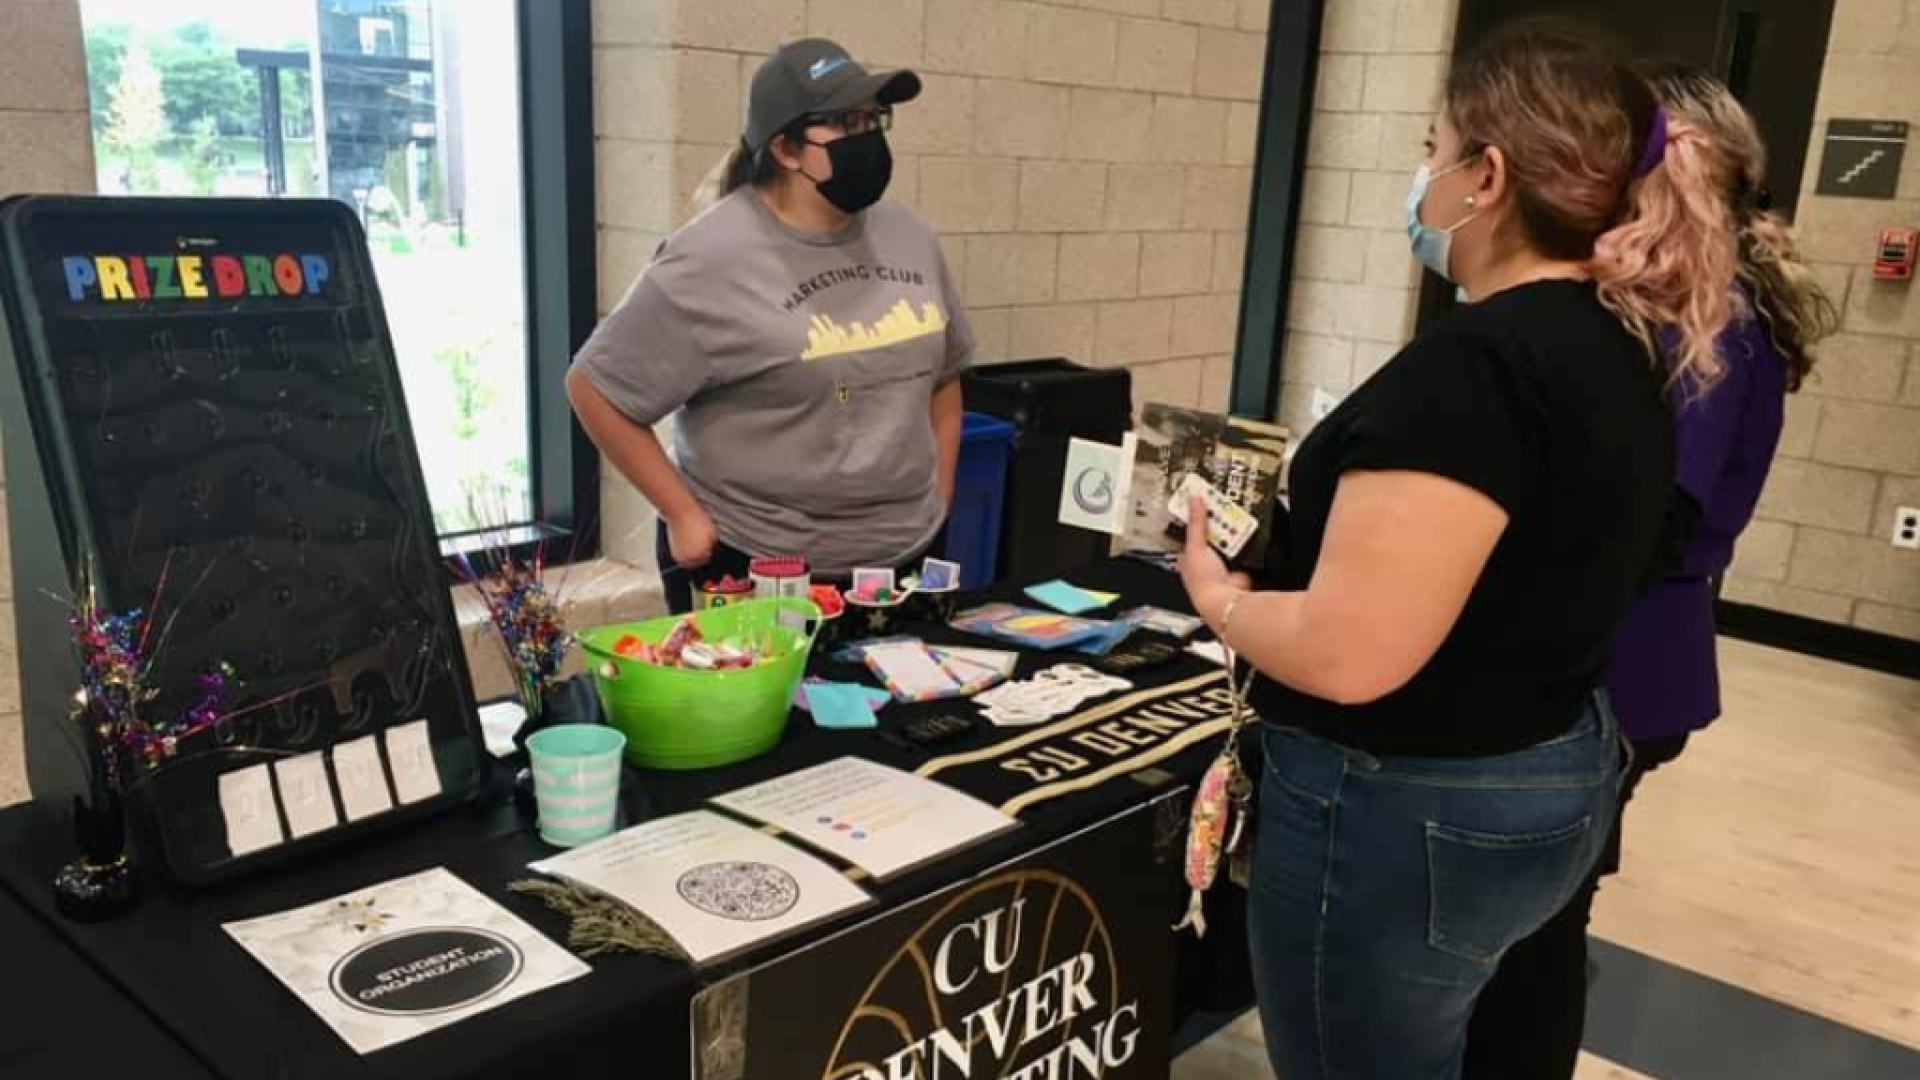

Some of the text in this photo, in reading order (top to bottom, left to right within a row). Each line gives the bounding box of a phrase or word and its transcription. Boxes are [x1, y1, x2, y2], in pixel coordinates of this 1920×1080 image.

[63, 253, 329, 301] PRIZE DROP
[784, 265, 924, 310] MARKETING CLUB
[1001, 688, 1233, 782] CU DENVER
[359, 946, 504, 1001] ORGANIZATION
[376, 947, 465, 982] STUDENT
[932, 897, 1027, 996] CU
[845, 952, 1098, 1080] ENVER
